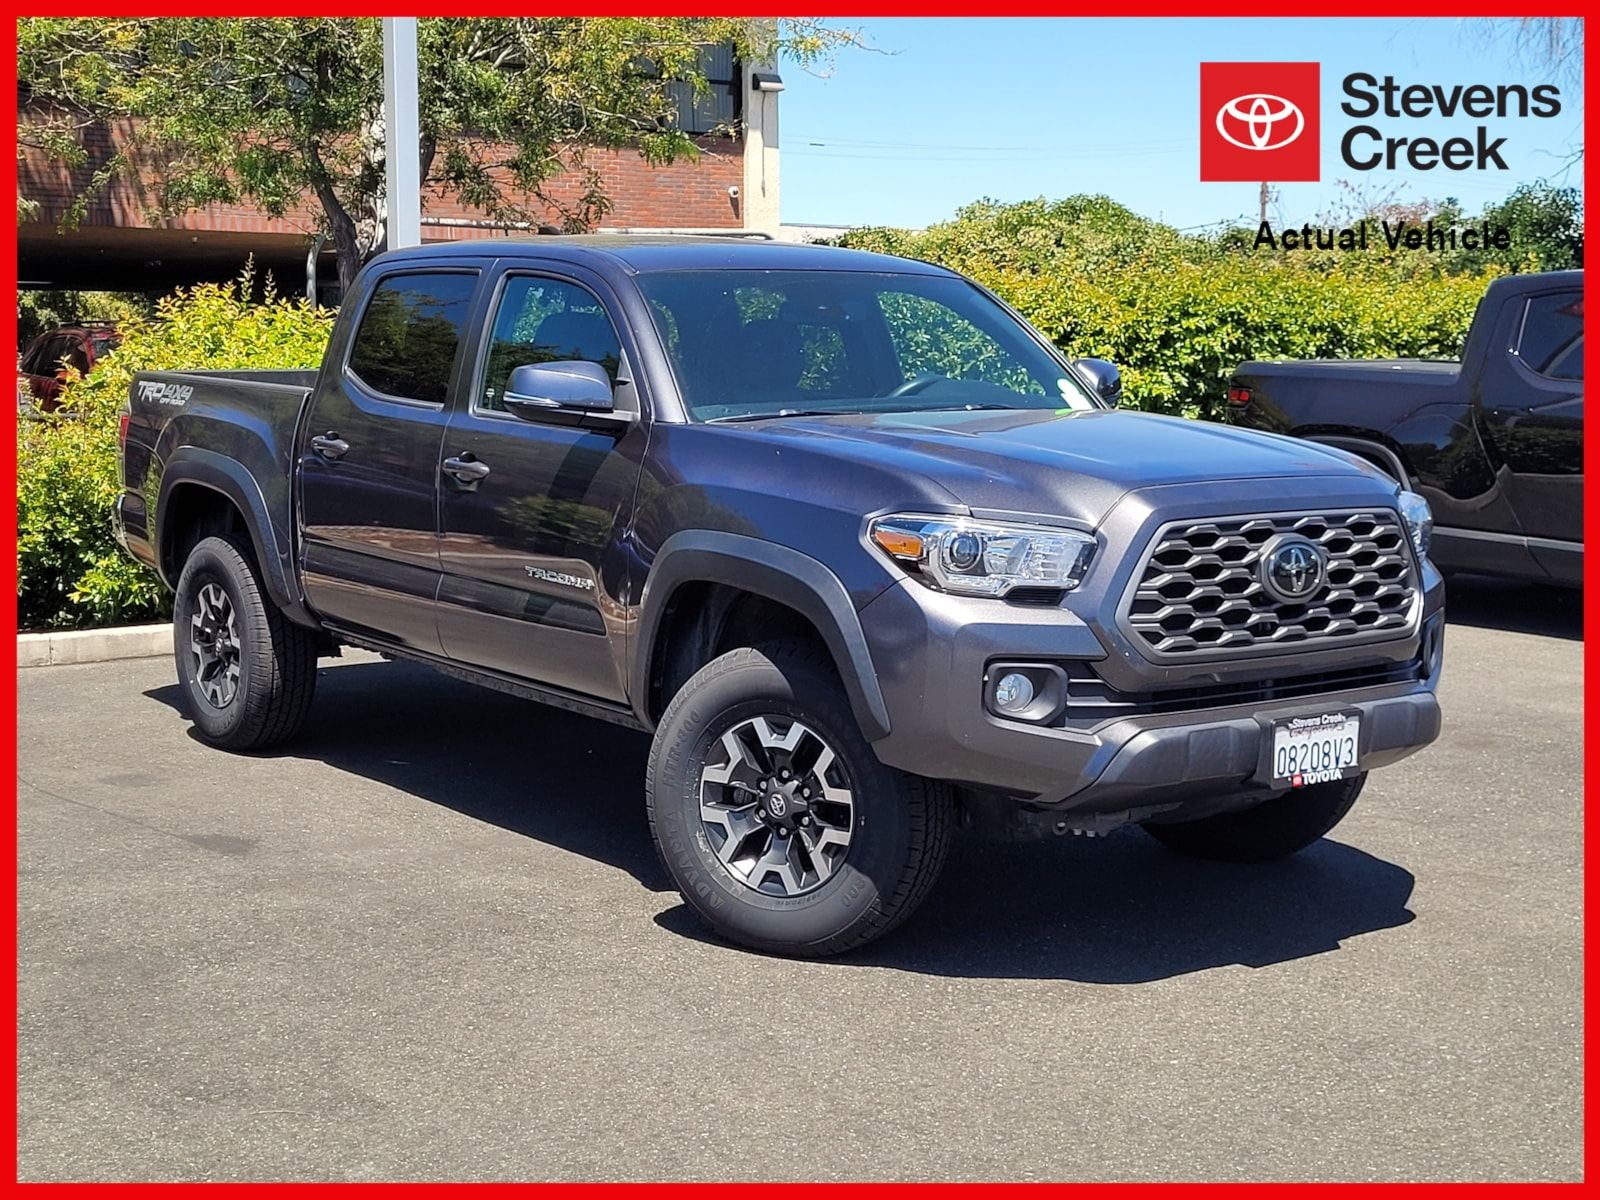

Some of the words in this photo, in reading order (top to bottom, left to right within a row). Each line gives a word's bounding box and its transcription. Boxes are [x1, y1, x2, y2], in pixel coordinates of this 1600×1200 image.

[138, 380, 166, 402] TRD
[524, 565, 595, 590] TACOMA
[1293, 717, 1321, 727] Stevens
[1321, 713, 1345, 724] Creek
[1277, 737, 1354, 776] 08208V3
[1302, 768, 1343, 785] TOYOTA
